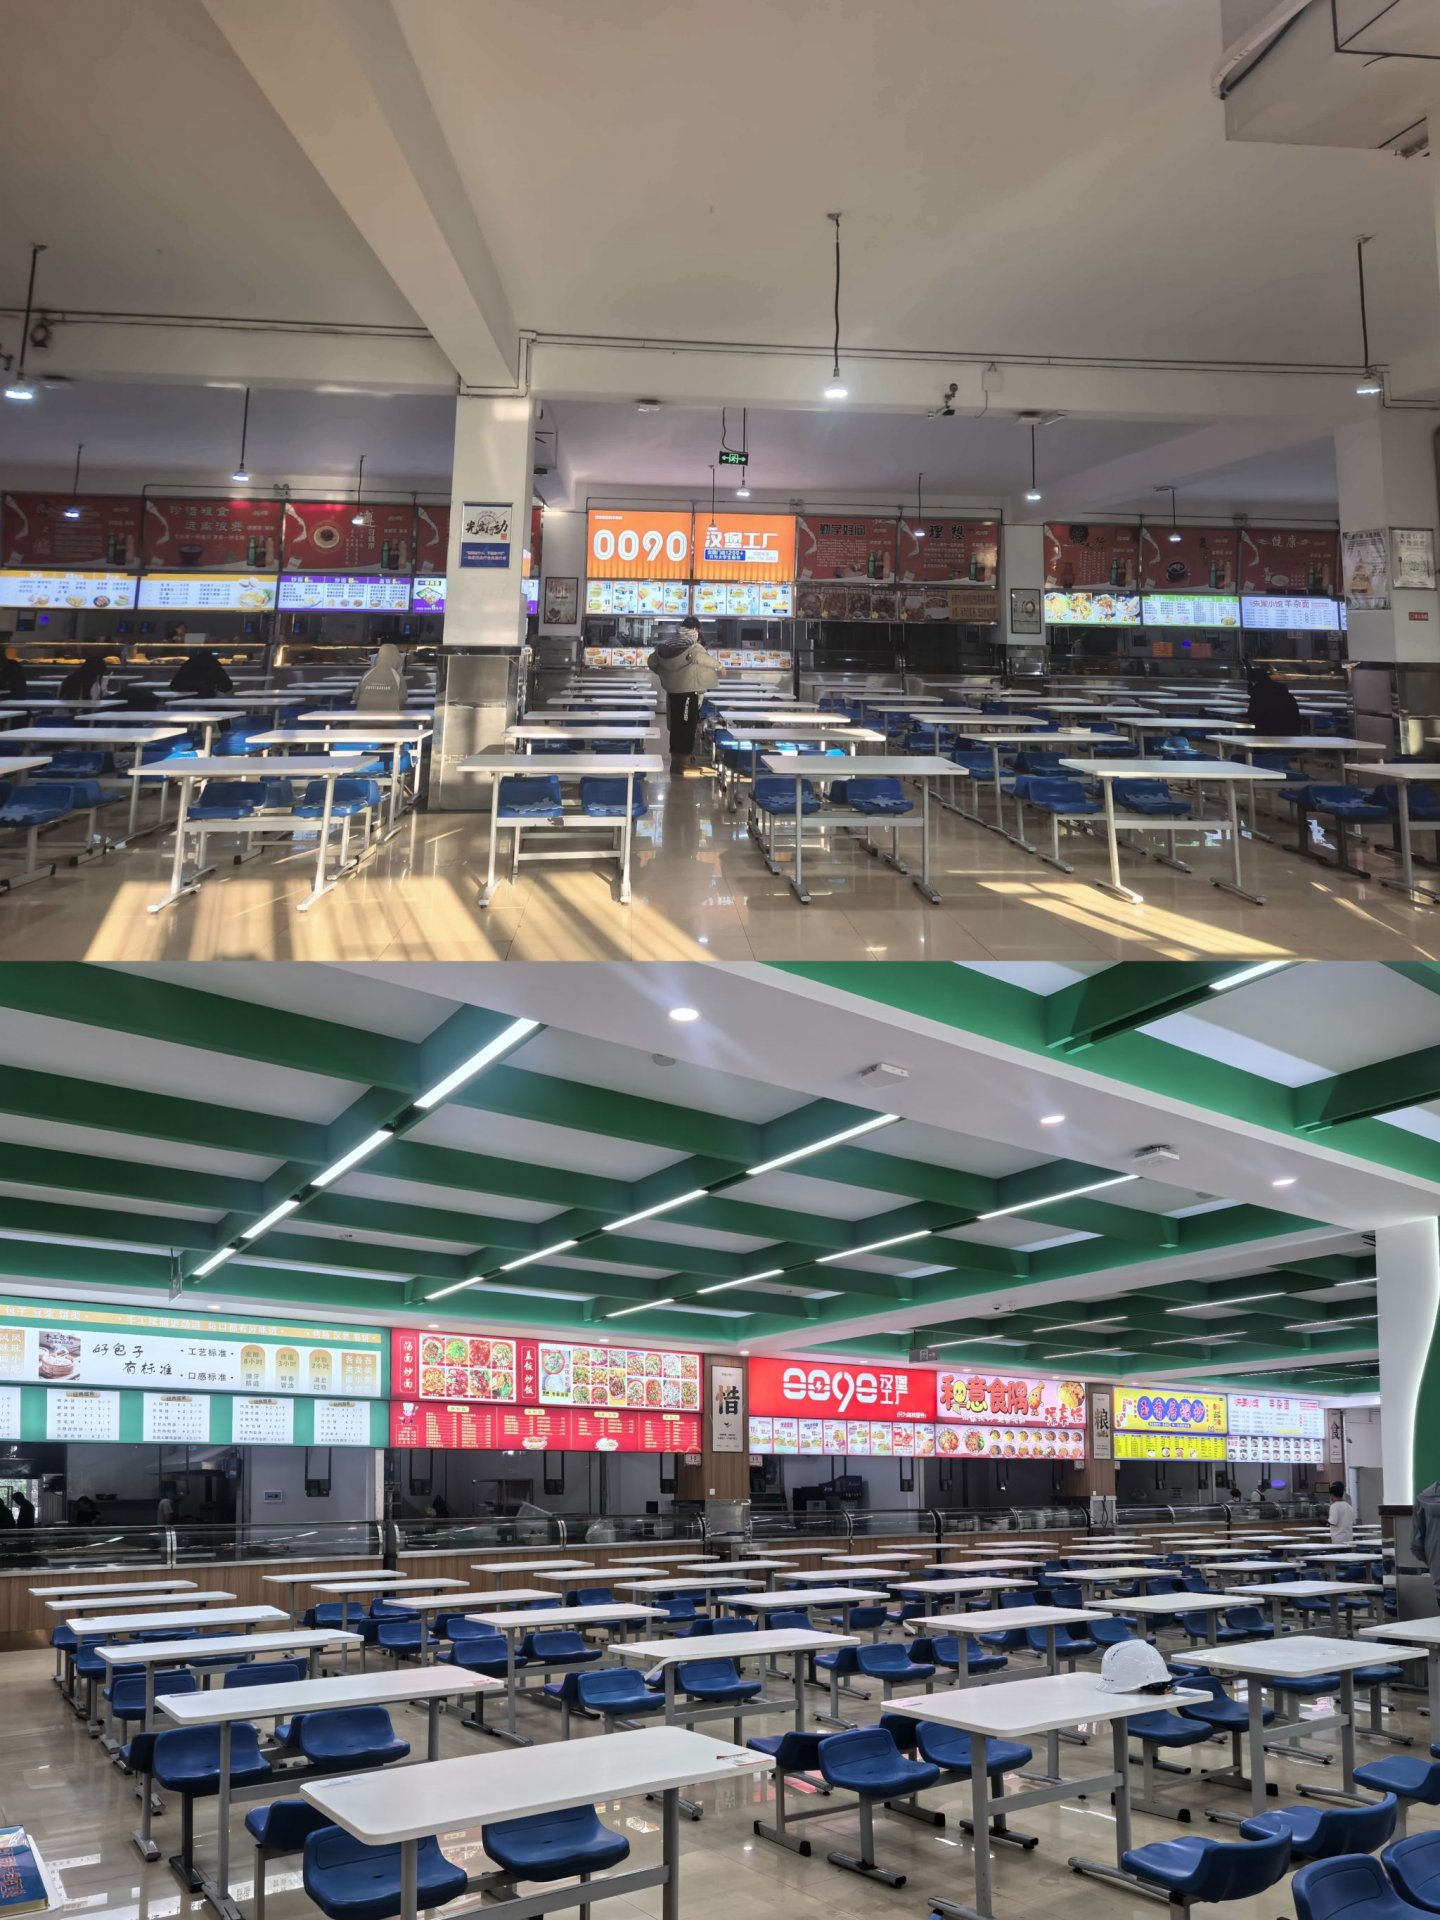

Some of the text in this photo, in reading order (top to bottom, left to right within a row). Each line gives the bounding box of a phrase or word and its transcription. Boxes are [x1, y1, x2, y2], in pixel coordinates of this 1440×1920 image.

[465, 519, 509, 536] 光盘行动
[819, 523, 866, 537] 勤学好问
[593, 529, 688, 561] 0090
[705, 530, 779, 549] 汉堡工厂
[92, 1342, 144, 1358] 好包子
[188, 1347, 227, 1358] 工艺标准
[122, 1360, 173, 1375] 有标准
[188, 1371, 227, 1382] 口感标准
[879, 1374, 908, 1390] 汉堡
[783, 1367, 878, 1412] 0090
[880, 1390, 908, 1405] 工厂
[715, 1384, 740, 1415] 惜
[1094, 1407, 1110, 1430] 粮
[1330, 1420, 1341, 1440] 食
